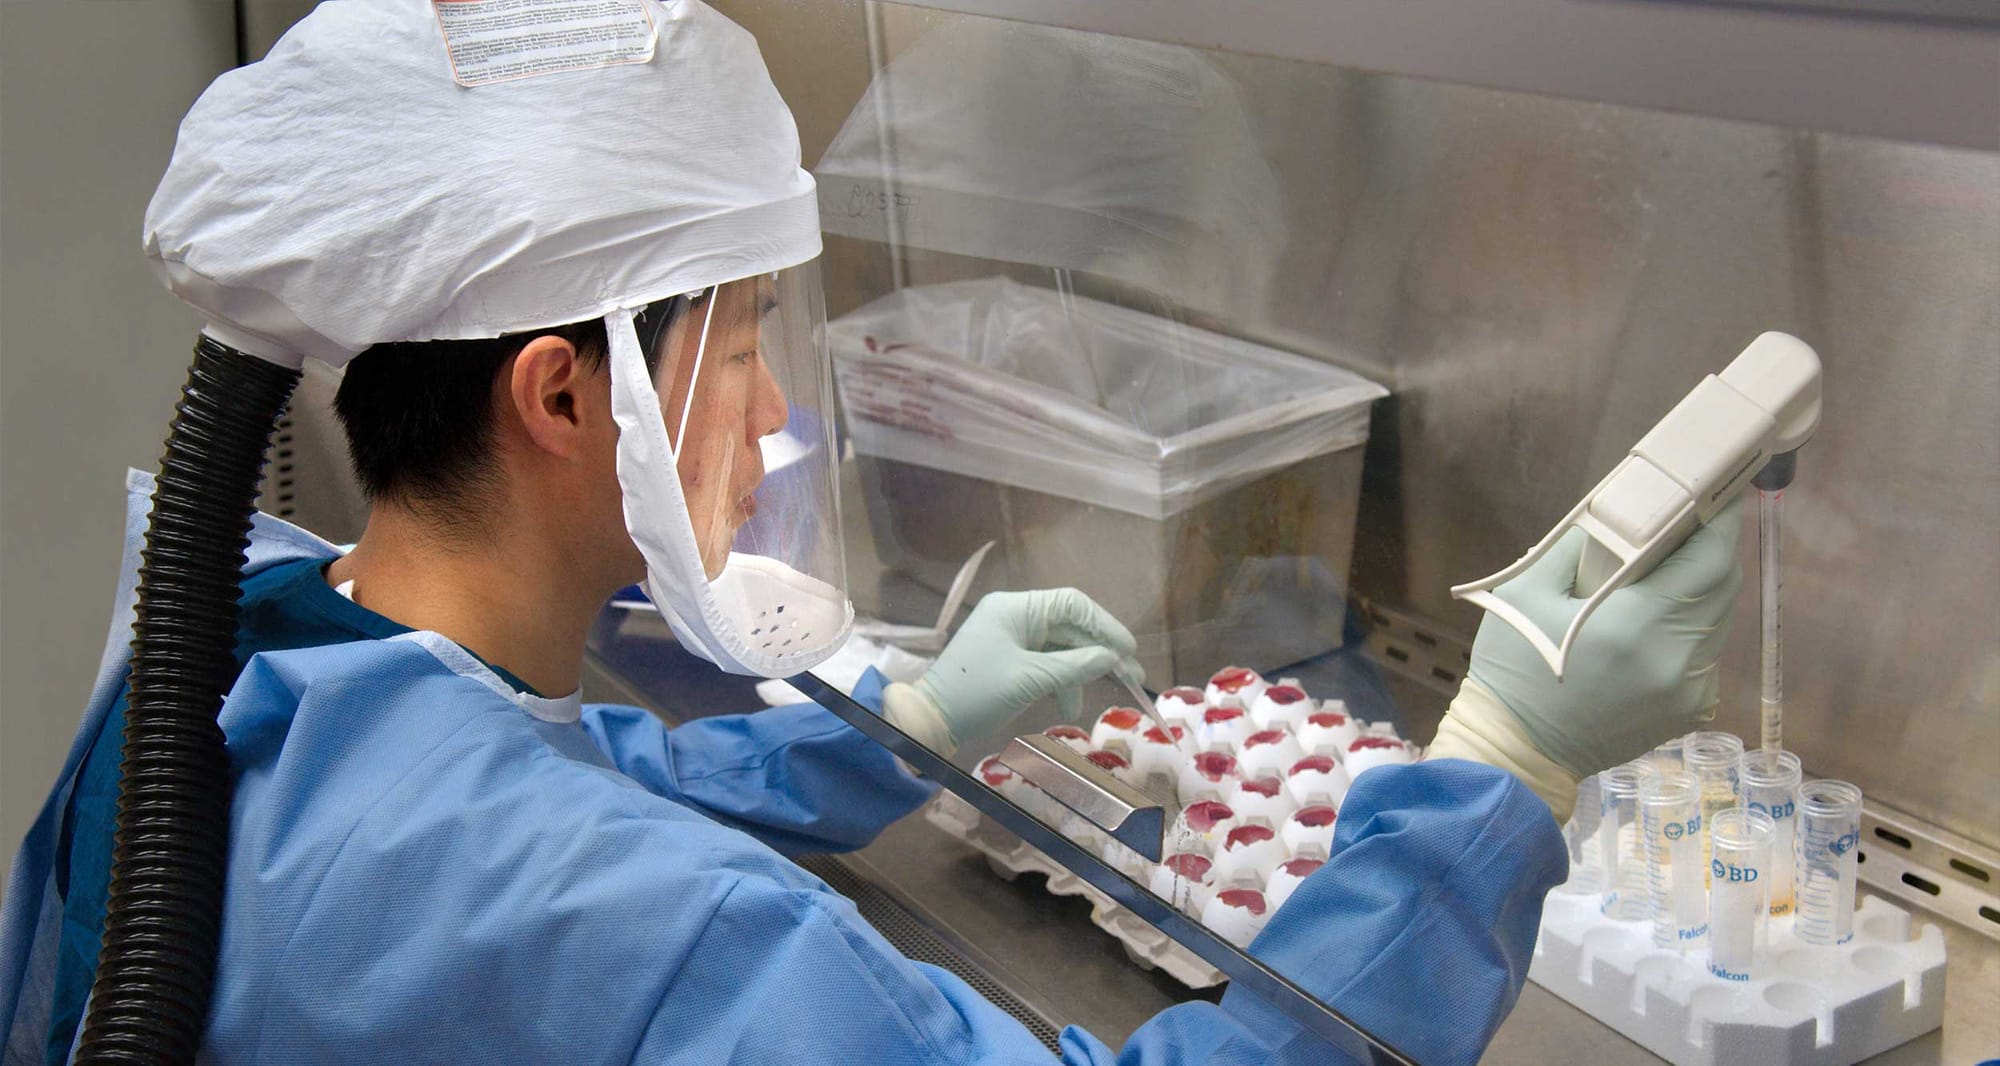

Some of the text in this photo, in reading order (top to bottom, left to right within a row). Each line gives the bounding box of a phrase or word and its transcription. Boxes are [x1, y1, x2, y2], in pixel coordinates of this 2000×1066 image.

[1771, 801, 1795, 819] BD
[1729, 866, 1758, 882] BD
[1711, 964, 1749, 982] Falcon
